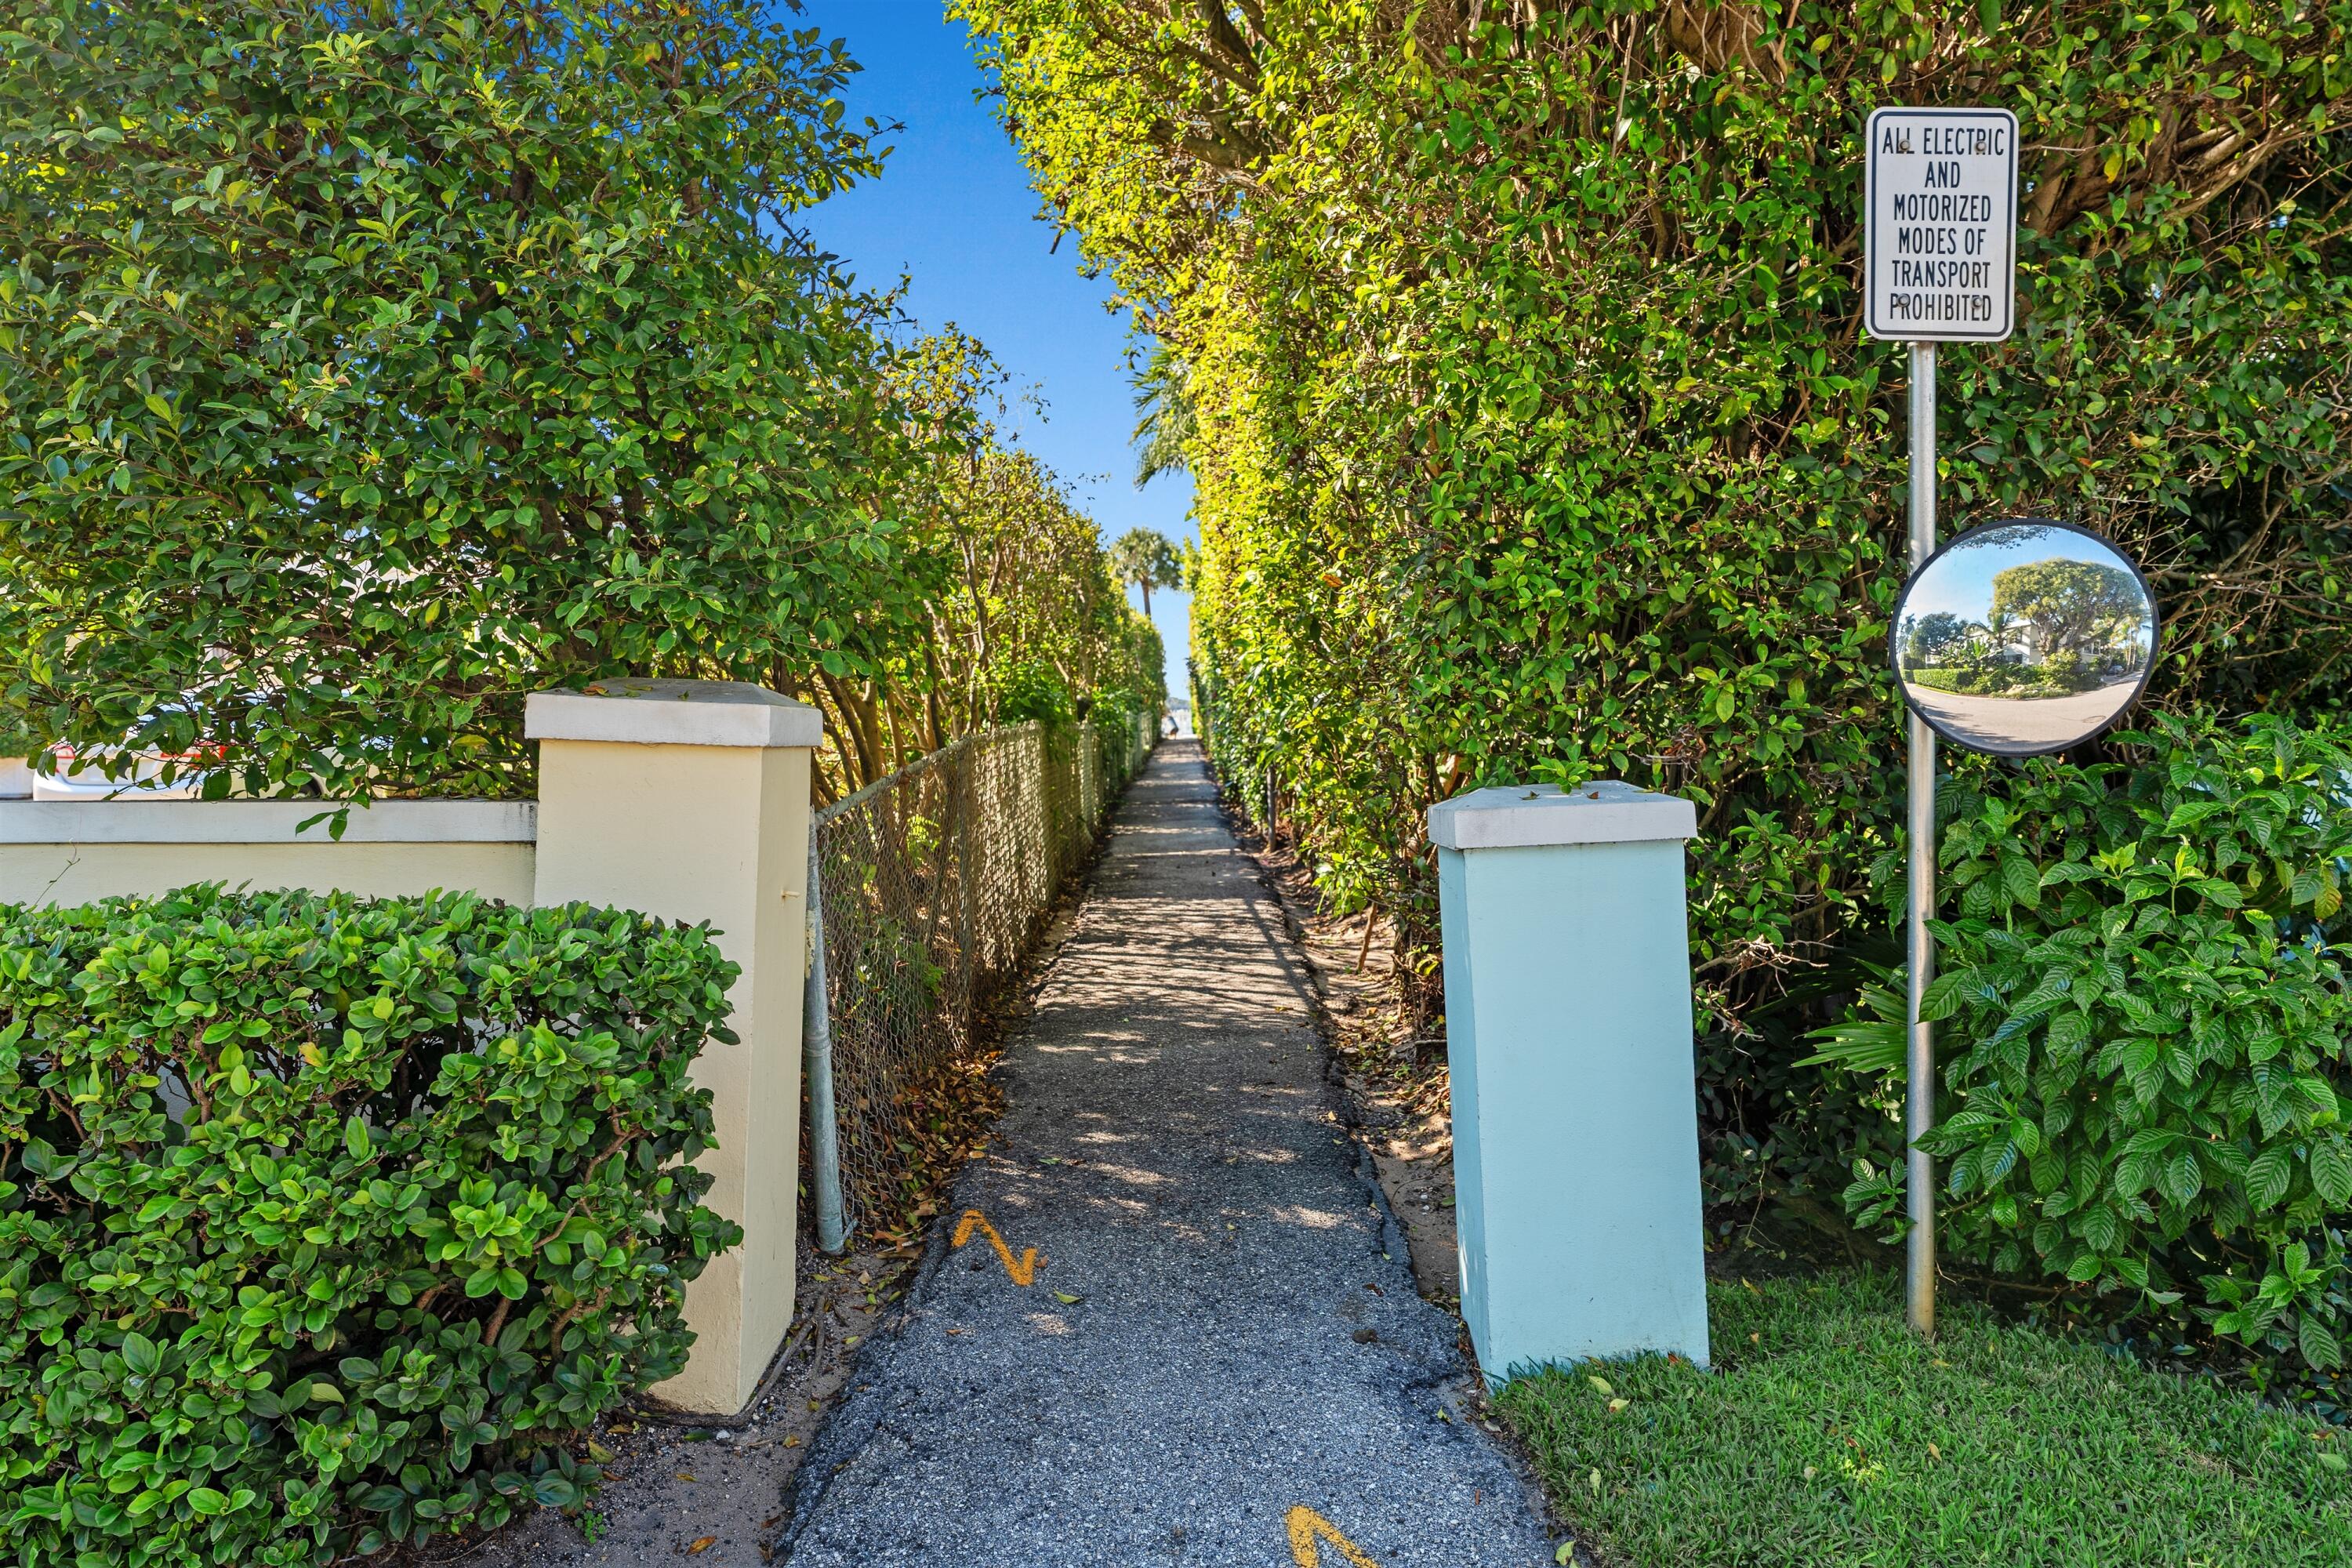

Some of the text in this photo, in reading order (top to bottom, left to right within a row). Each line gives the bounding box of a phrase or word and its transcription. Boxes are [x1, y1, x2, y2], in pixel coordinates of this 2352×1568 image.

[1882, 127, 2005, 155] ALL ELECTRIC
[1925, 162, 1960, 188] AND
[1894, 194, 1991, 222] MOTORIZED
[1898, 227, 1986, 256] MODES OF
[1892, 260, 1991, 288] TRANSPORT
[1890, 293, 1991, 321] PROHIBITED
